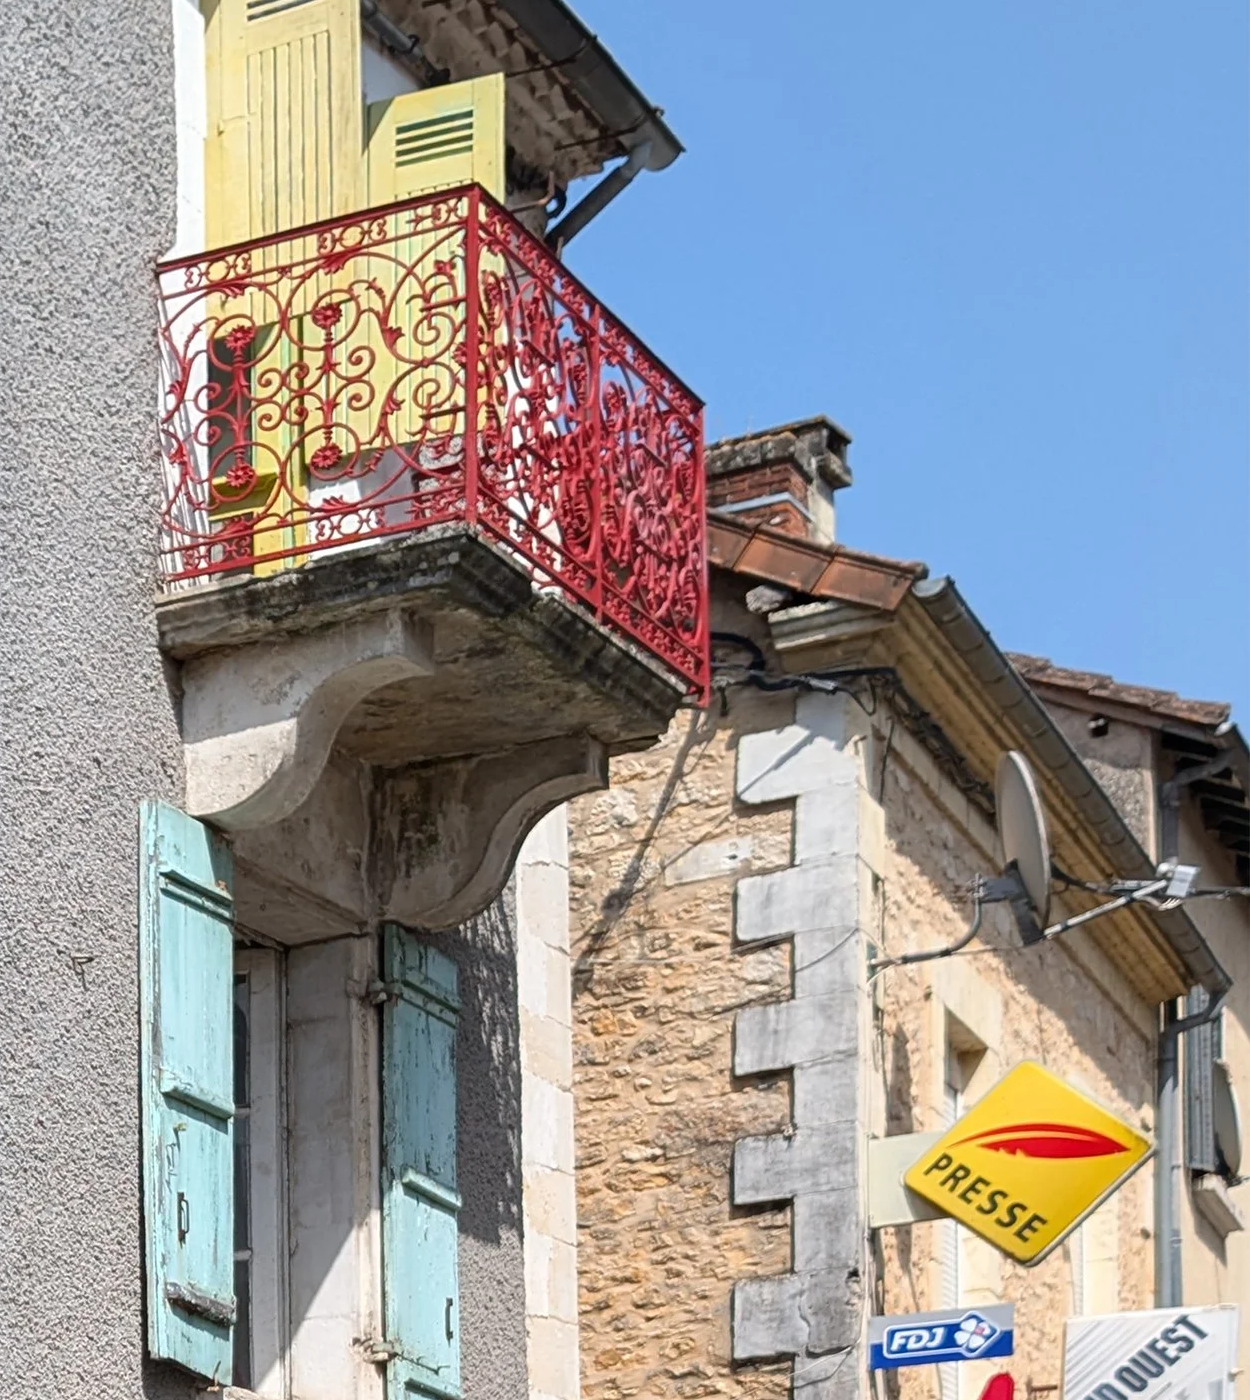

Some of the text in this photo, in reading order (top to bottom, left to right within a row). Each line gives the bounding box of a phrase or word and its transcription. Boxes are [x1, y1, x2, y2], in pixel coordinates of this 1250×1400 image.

[923, 1152, 1048, 1243] PRESSE
[890, 1327, 945, 1351] FDJ
[1114, 1315, 1208, 1392] OUEST
